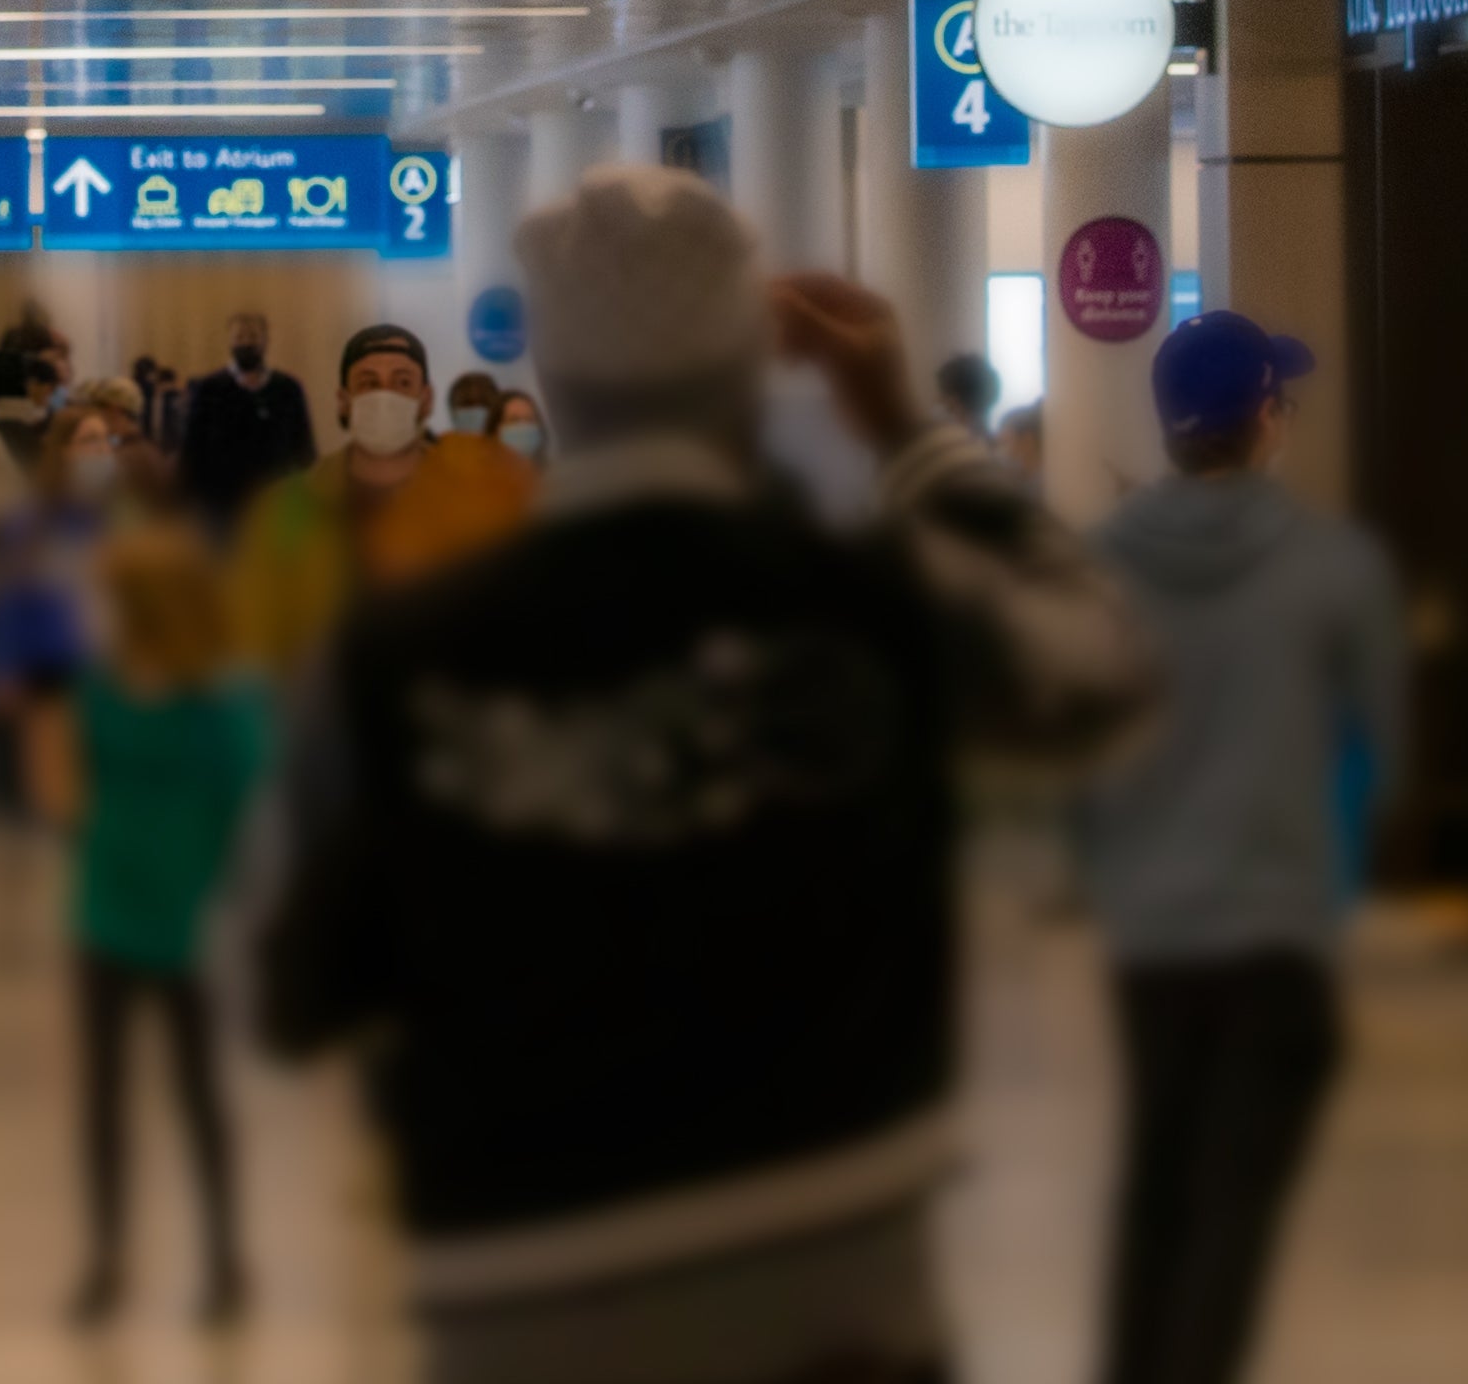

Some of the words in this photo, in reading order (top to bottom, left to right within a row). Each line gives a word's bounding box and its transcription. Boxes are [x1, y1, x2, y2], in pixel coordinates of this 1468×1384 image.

[993, 9, 1035, 37] the
[952, 79, 991, 135] 4
[401, 167, 427, 193] A
[403, 204, 425, 241] 2
